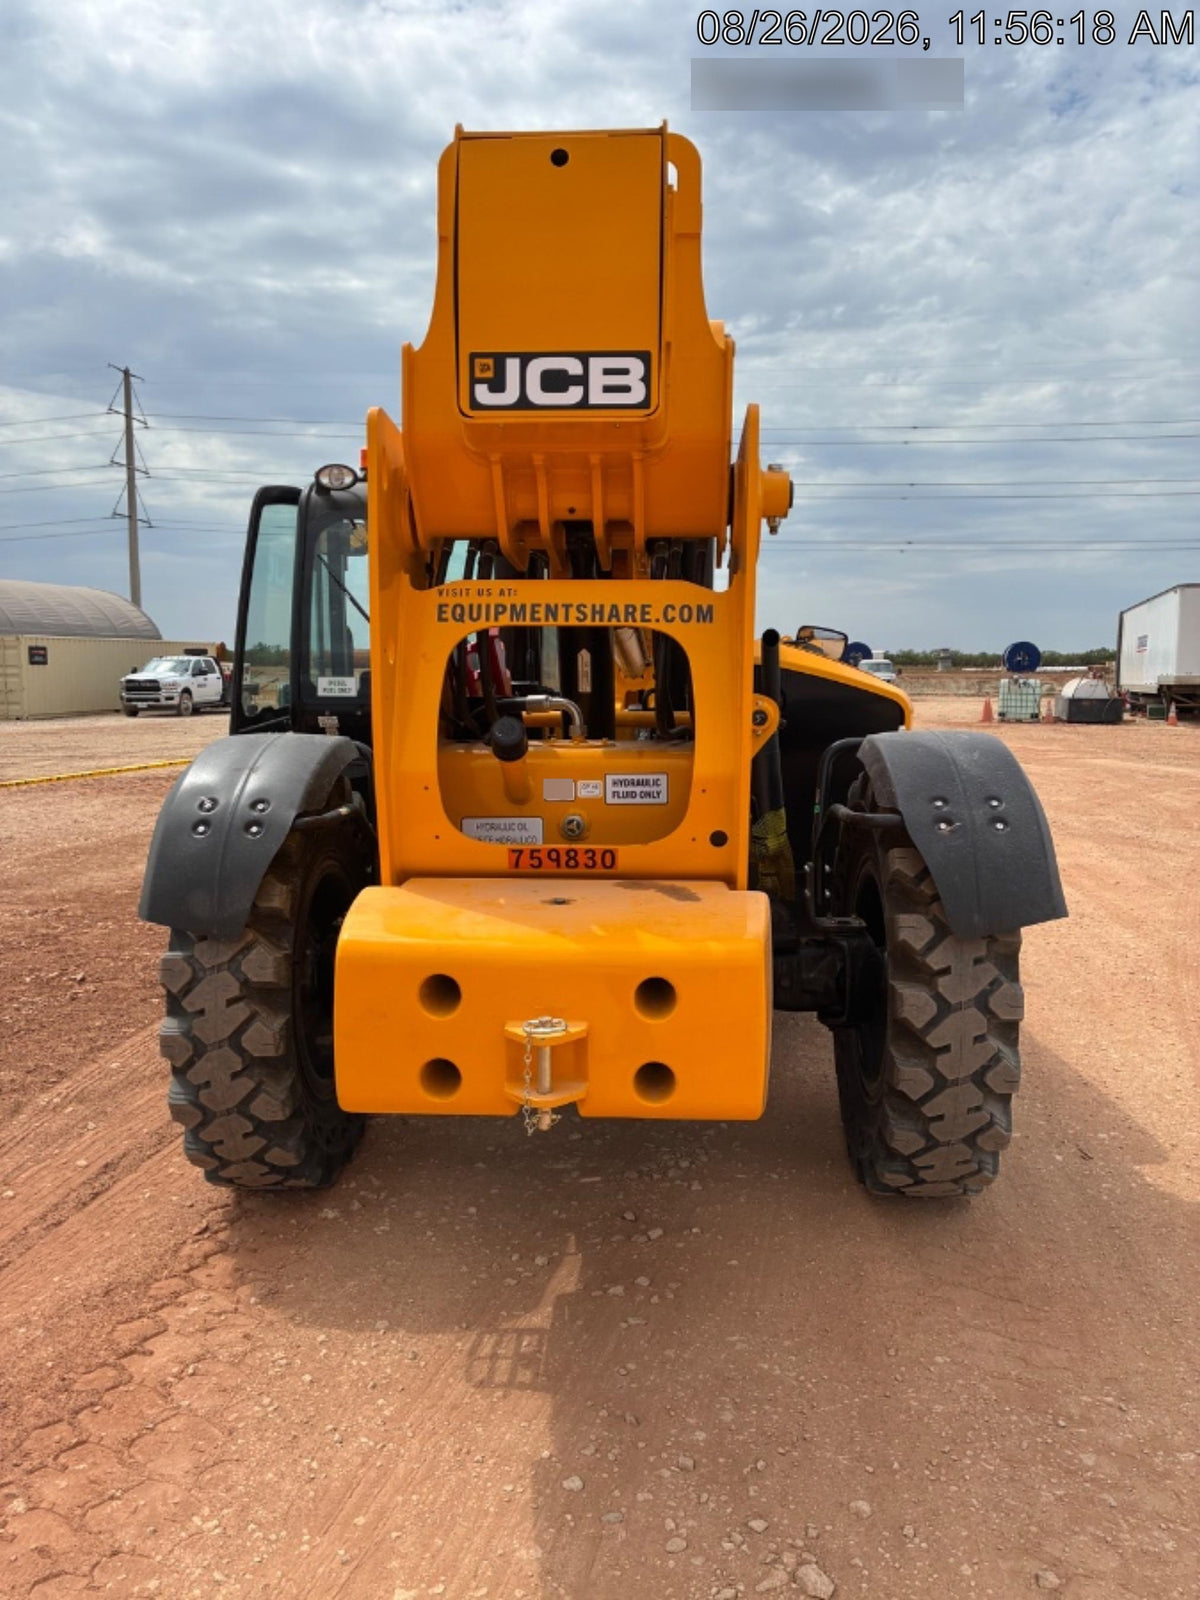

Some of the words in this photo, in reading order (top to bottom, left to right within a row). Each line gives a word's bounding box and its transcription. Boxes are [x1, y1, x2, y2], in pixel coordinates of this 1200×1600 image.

[474, 357, 647, 406] JCB
[437, 588, 471, 597] VISIT
[477, 588, 492, 597] US
[499, 588, 518, 597] AT:
[437, 603, 714, 624] EQUIPMENTSHARE.COM
[612, 778, 661, 788] HYDRAULIC
[612, 790, 637, 799] FLUID
[639, 790, 662, 799] ONLY
[511, 848, 616, 870] 759830
